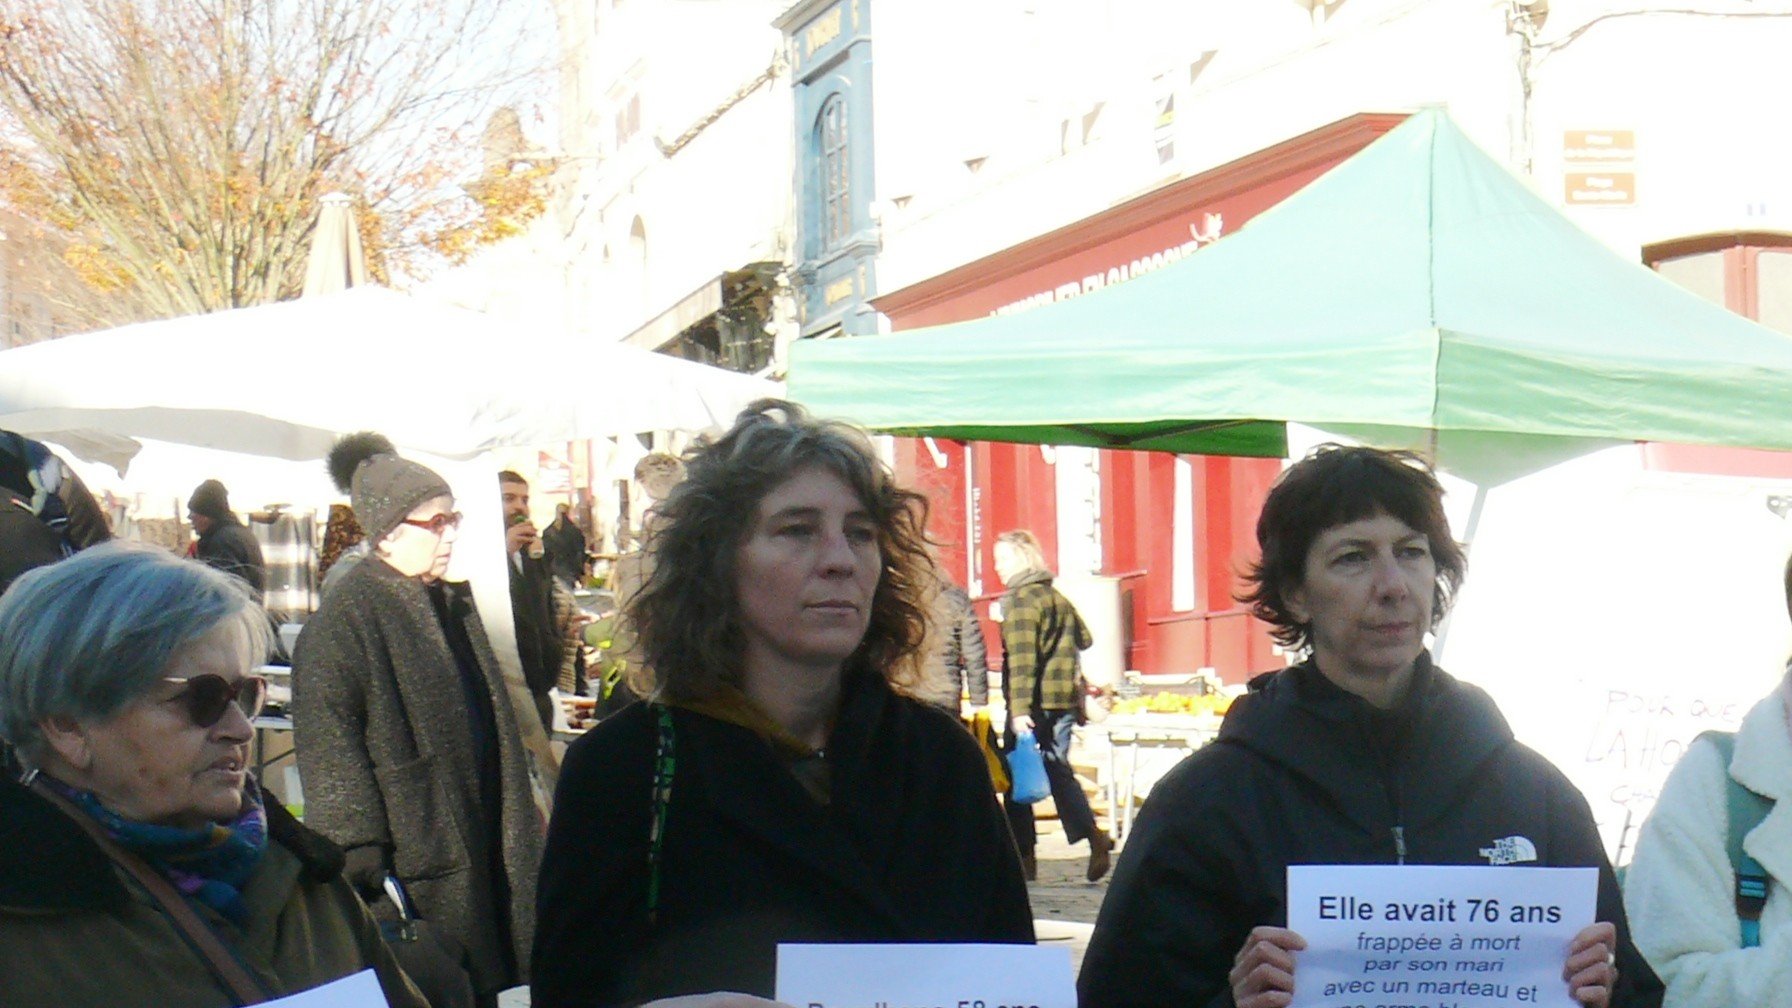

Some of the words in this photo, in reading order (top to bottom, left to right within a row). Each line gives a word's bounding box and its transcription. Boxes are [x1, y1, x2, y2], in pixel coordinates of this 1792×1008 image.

[1690, 699, 1737, 723] QUE
[1319, 896, 1374, 920] Elle
[1385, 898, 1456, 922] avait
[1467, 899, 1499, 922] 76
[1510, 905, 1562, 923] ans
[1357, 932, 1442, 953] frappée
[1450, 934, 1463, 950] à
[1471, 934, 1521, 950] mort
[1363, 960, 1402, 973] par
[1408, 960, 1447, 972] son
[1455, 958, 1503, 972] mari
[1324, 979, 1375, 996] avec
[1383, 981, 1409, 993] un
[1417, 980, 1508, 998] marteau
[1516, 985, 1538, 1002] et
